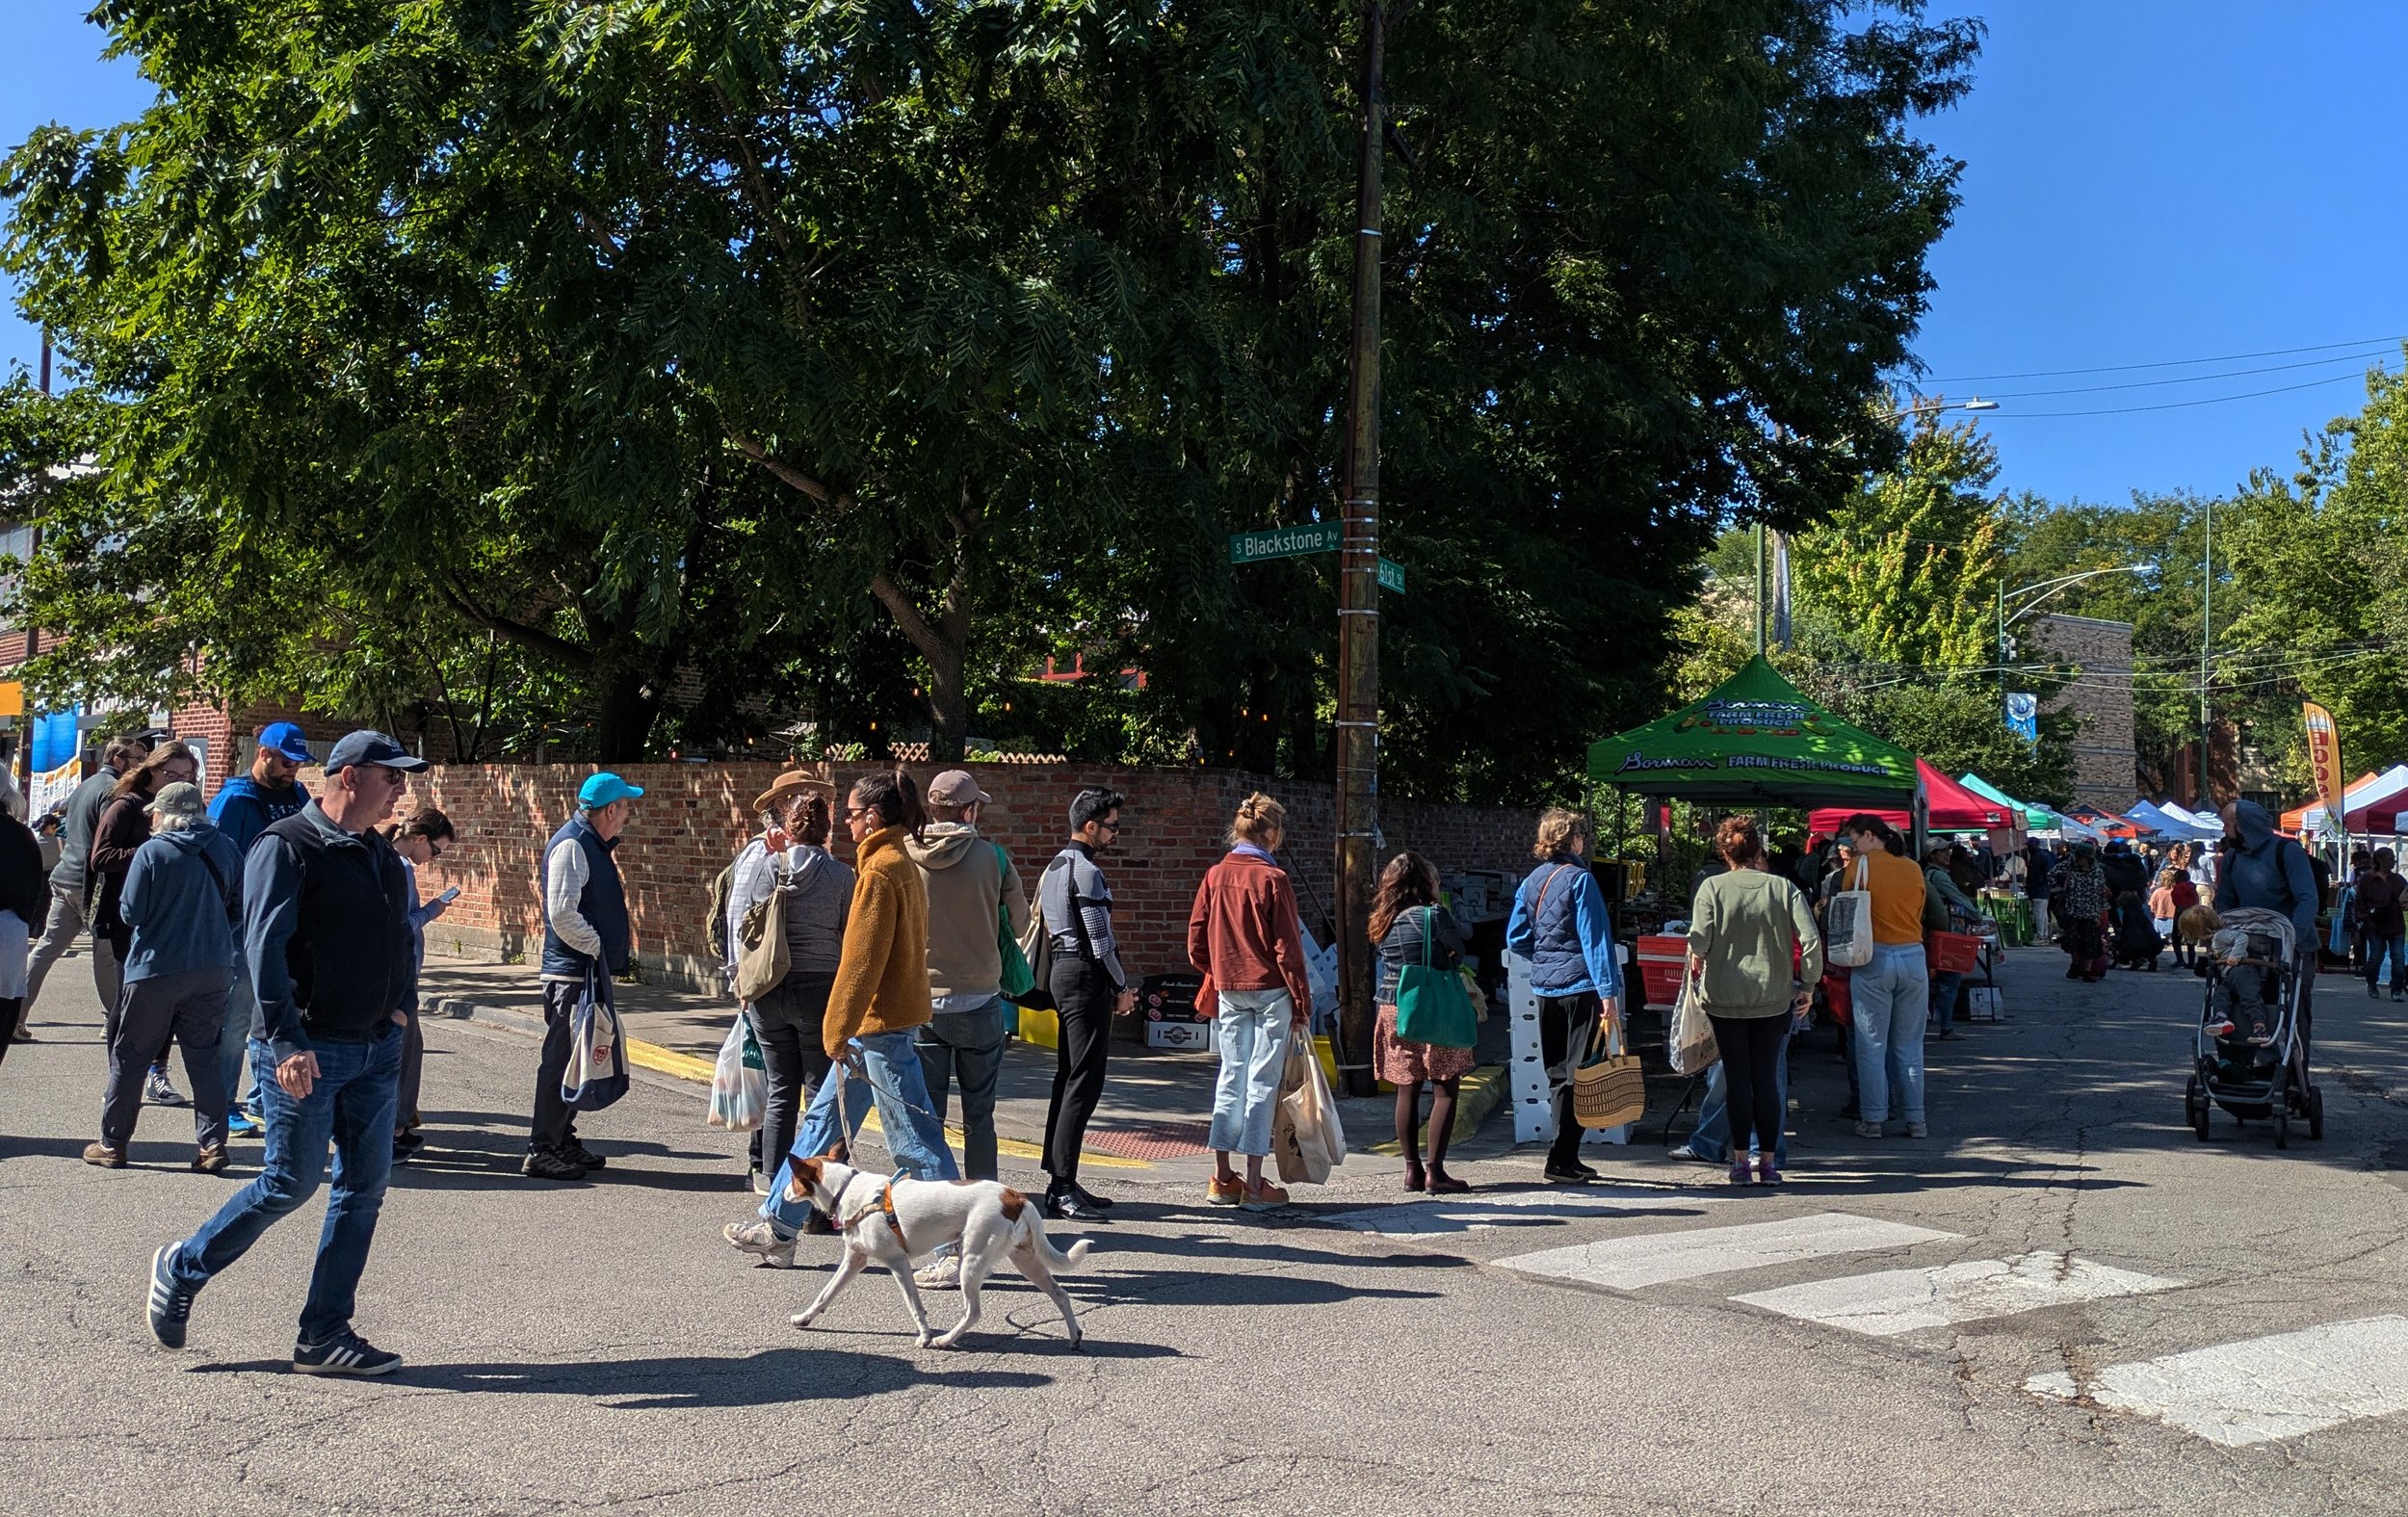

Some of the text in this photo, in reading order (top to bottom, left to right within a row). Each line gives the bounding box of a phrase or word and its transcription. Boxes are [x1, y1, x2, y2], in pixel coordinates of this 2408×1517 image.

[1236, 530, 1338, 556] S Blackstone Av
[1379, 562, 1395, 587] 61st
[1696, 697, 1812, 713] Gorman
[1718, 718, 1793, 727] PRODUCE
[1755, 711, 1804, 719] FRESH
[1615, 751, 1889, 774] Gorman FARM FRESH PRODUCE
